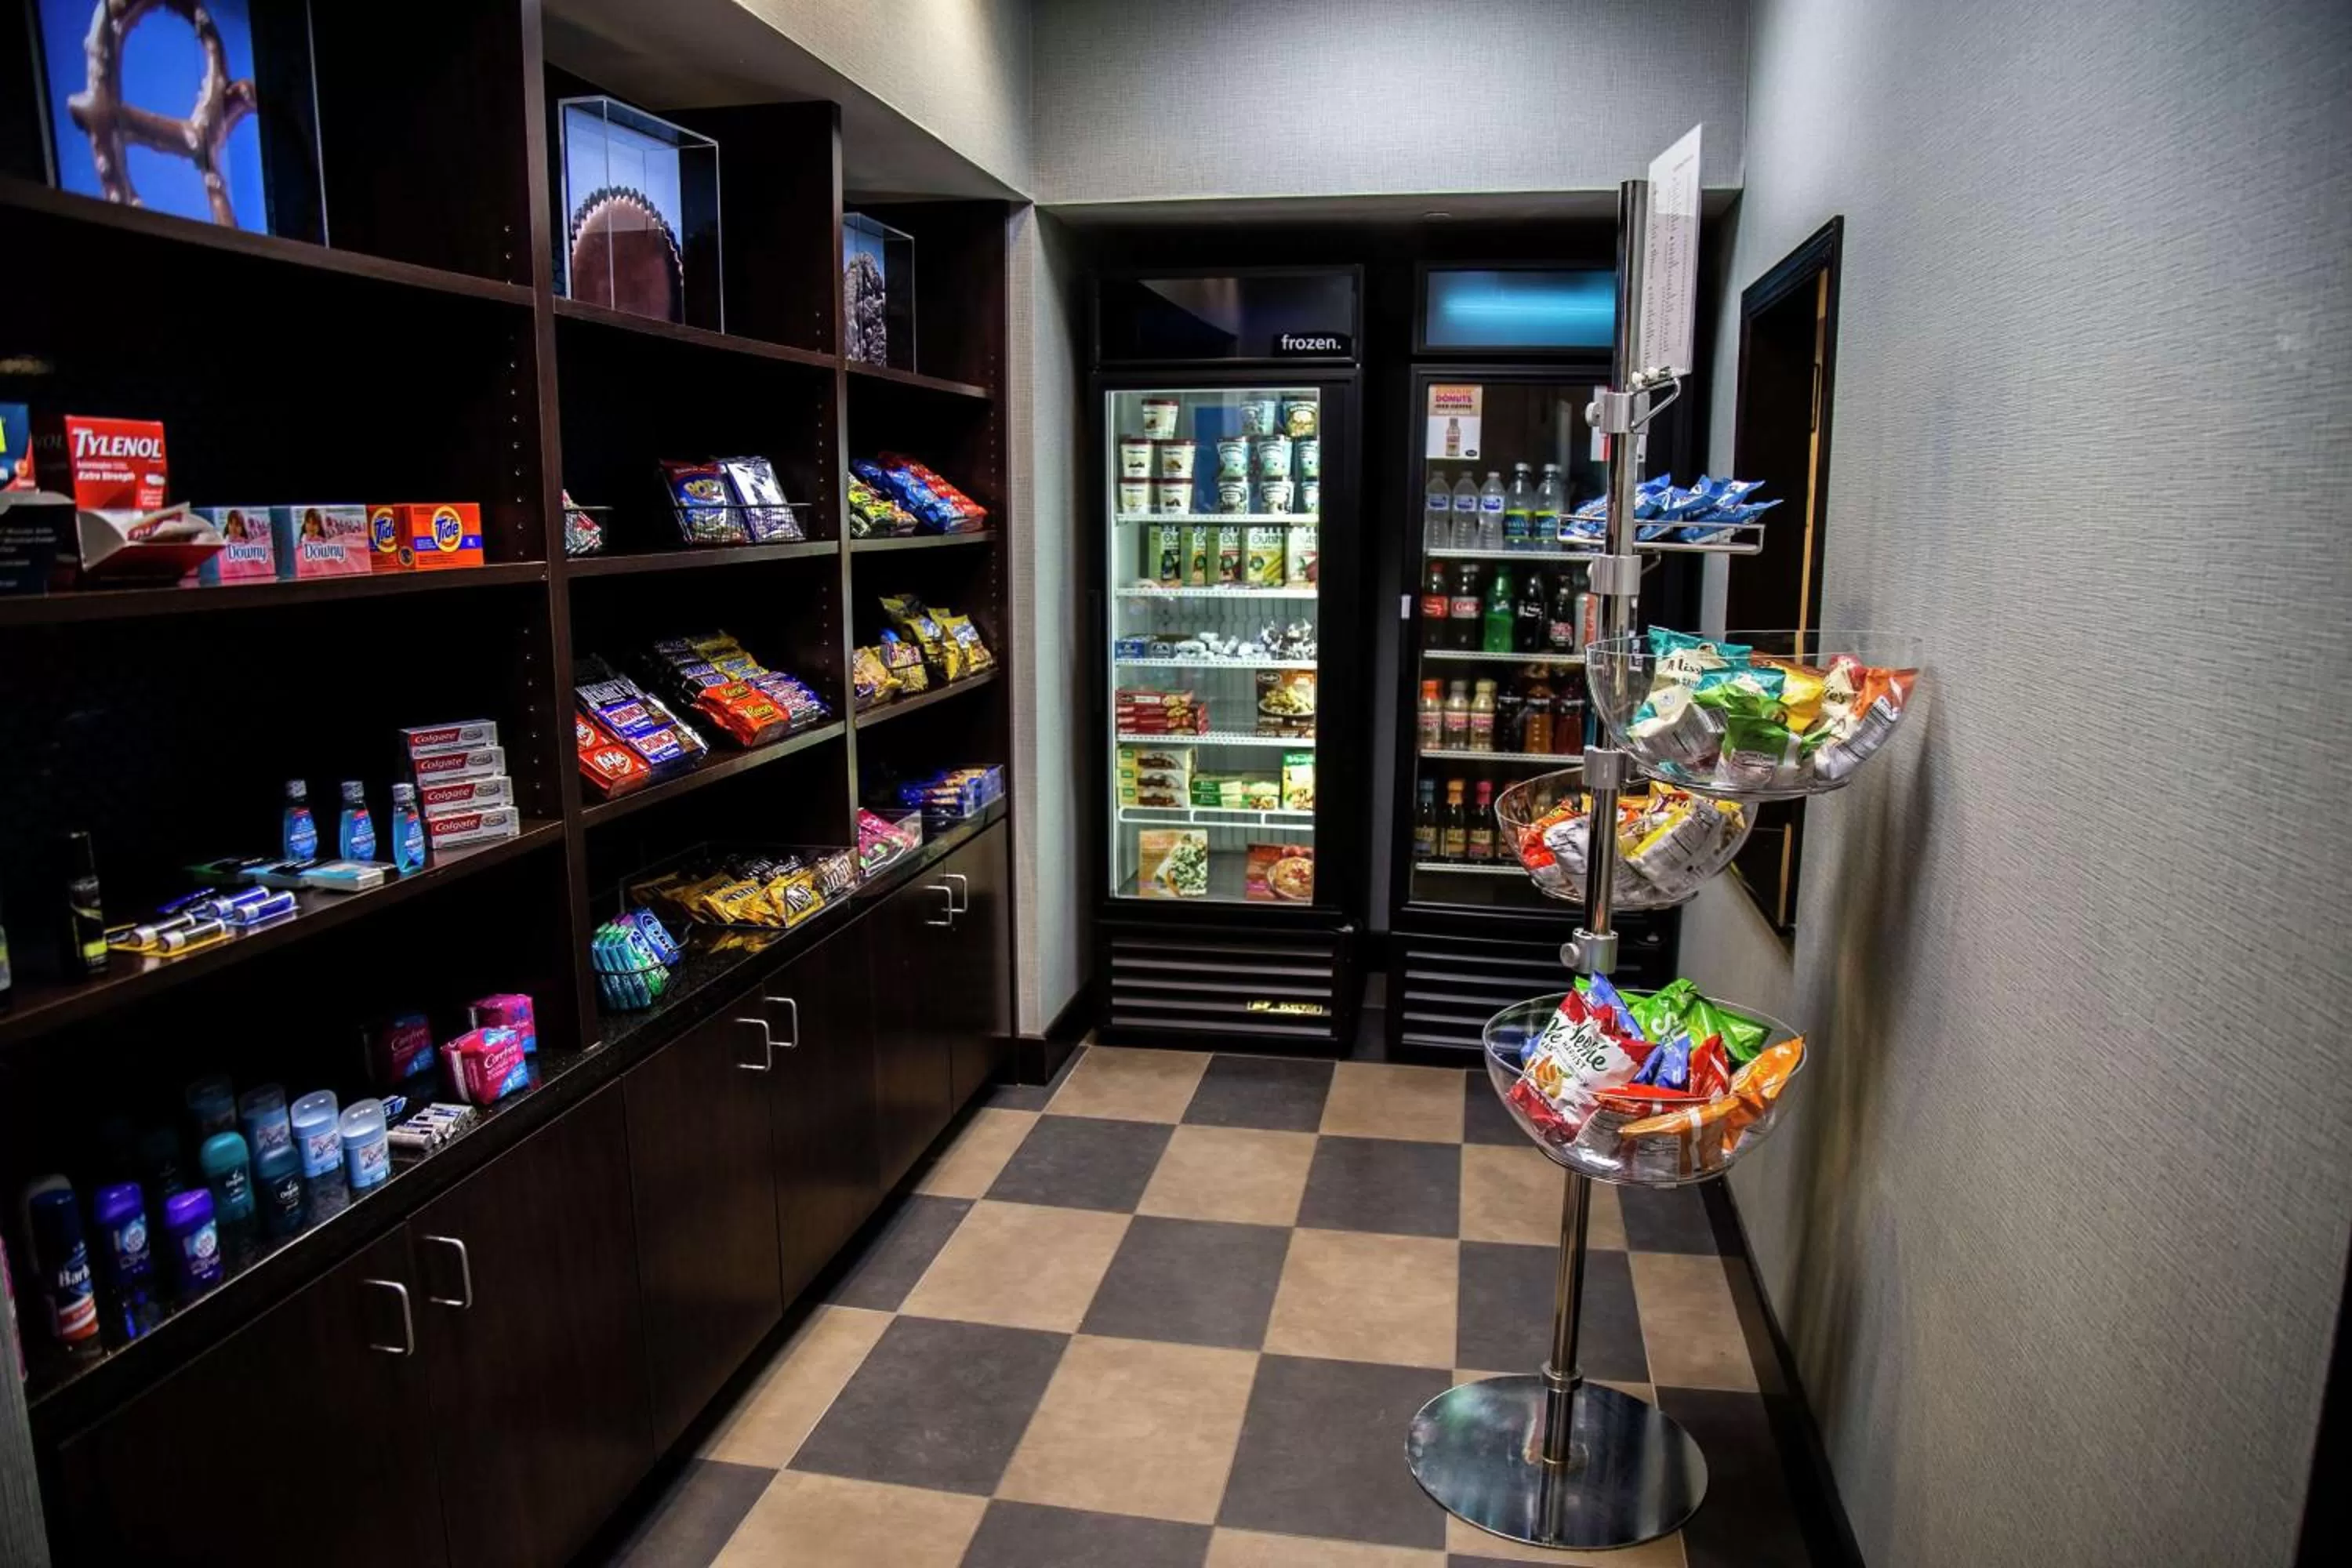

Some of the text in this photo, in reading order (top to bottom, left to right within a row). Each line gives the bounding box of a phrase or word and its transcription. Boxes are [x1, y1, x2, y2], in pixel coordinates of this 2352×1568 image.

[1281, 334, 1341, 351] frozen.
[73, 427, 163, 458] TYLENOL
[374, 518, 397, 543] Tid
[434, 517, 459, 541] Tide
[227, 543, 267, 563] Downy
[304, 543, 344, 563] Downy
[414, 731, 457, 745] Colgate
[420, 757, 464, 770] Colgate
[427, 786, 470, 801] Colgate
[434, 818, 478, 832] Colgate
[1570, 1023, 1609, 1072] Veggie
